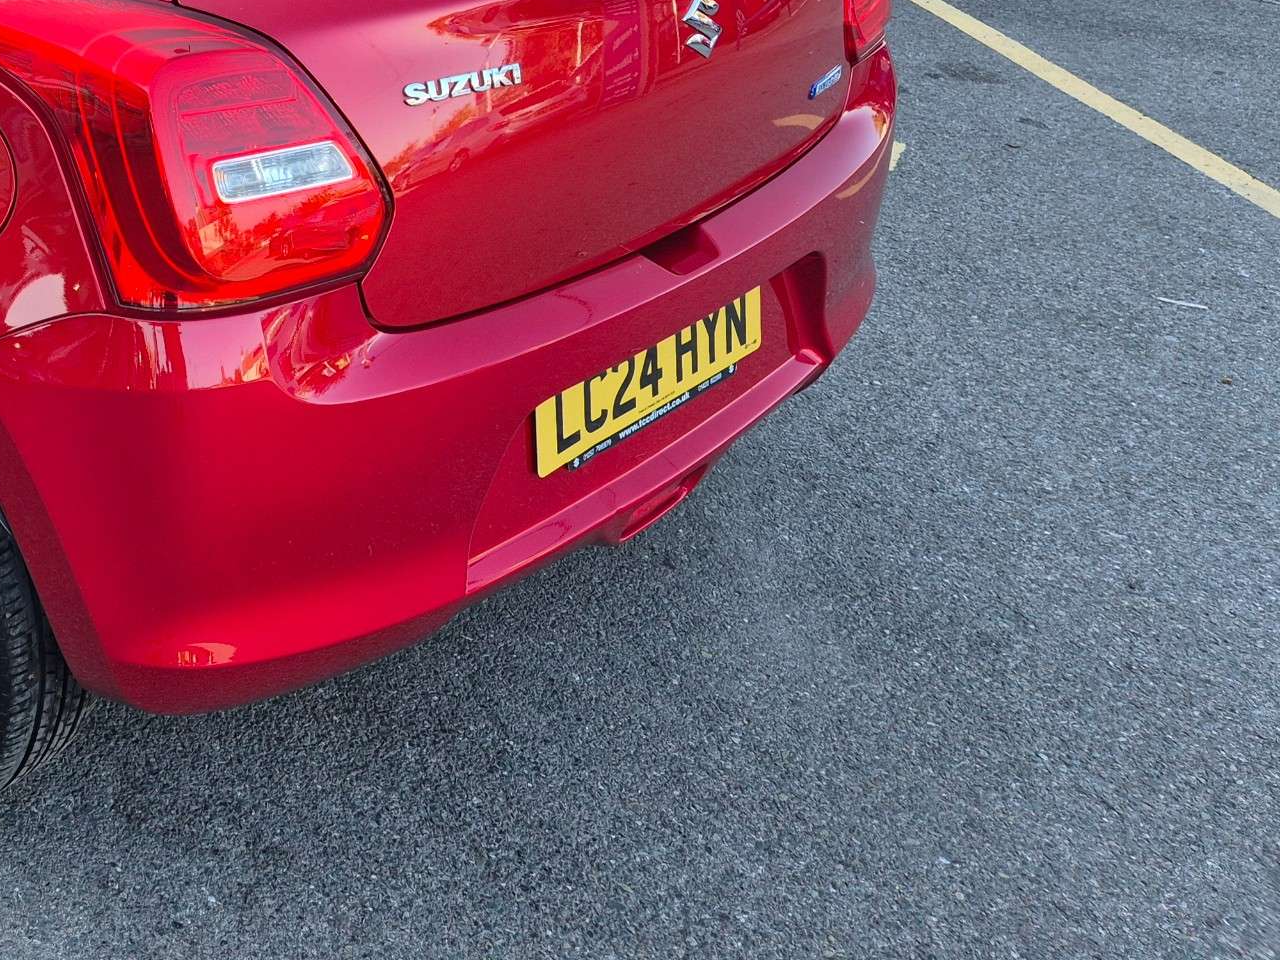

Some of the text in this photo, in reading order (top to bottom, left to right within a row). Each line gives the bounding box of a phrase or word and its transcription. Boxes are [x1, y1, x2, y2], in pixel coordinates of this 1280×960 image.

[403, 63, 522, 106] SUZUKI
[554, 293, 747, 455] LC24 HYN
